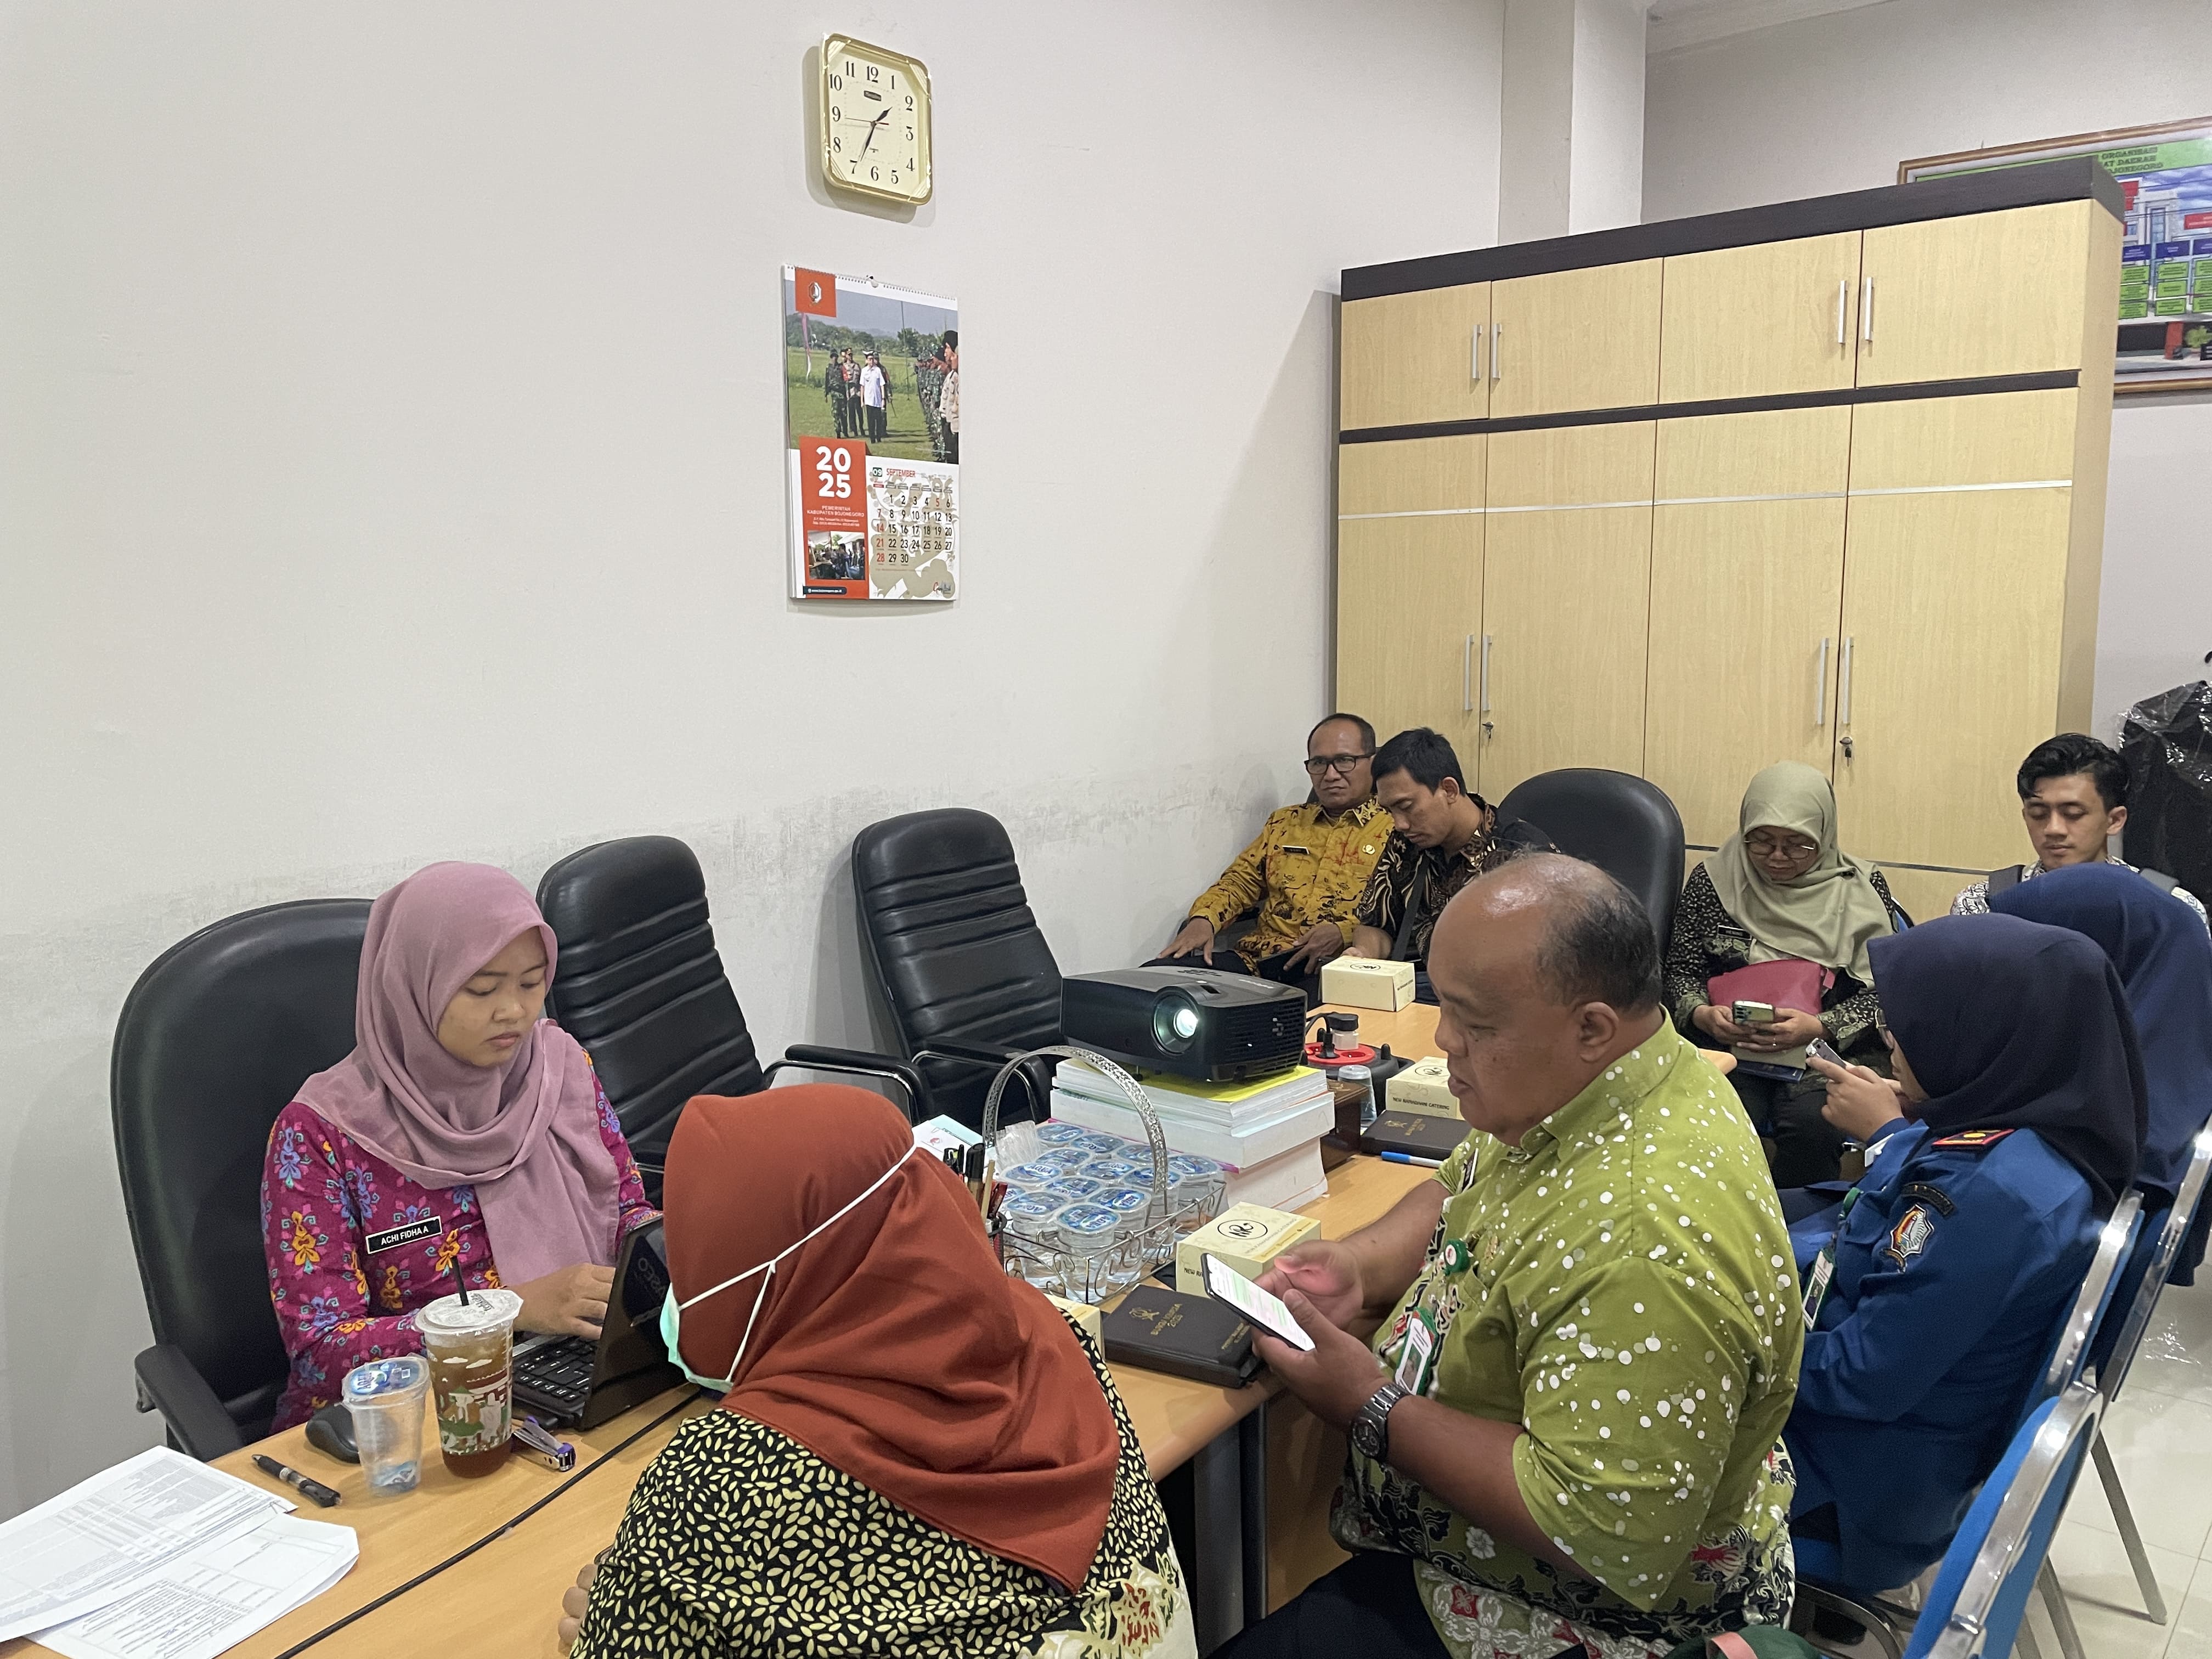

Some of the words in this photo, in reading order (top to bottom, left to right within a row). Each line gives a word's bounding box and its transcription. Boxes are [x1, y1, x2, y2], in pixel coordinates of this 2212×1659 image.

[846, 61, 855, 77] 11
[867, 66, 878, 83] 12
[830, 74, 842, 91] 10
[891, 75, 895, 89] 1
[905, 96, 913, 111] 2
[832, 106, 840, 121] 9
[906, 126, 913, 140] 3
[833, 137, 841, 153] 8
[850, 160, 857, 174] 7
[906, 158, 915, 171] 4
[2107, 162, 2164, 173] JONEGORO
[871, 166, 878, 180] 6
[891, 170, 899, 184] 5
[816, 446, 851, 472] 20
[887, 468, 916, 477] SEPTEMBER
[819, 472, 851, 498] 25
[890, 495, 893, 503] 1
[901, 495, 905, 505] 2
[913, 496, 917, 505] 3
[925, 498, 928, 506] 4
[936, 498, 939, 507] 5
[946, 499, 950, 507] 6
[877, 509, 881, 517] 7
[890, 509, 894, 518] 8
[901, 510, 906, 518] 9
[912, 511, 919, 520] 10
[923, 512, 930, 521] 11
[934, 512, 941, 521] 12
[945, 513, 952, 522] 13
[877, 523, 884, 532] 14
[889, 524, 896, 533] 15
[901, 524, 909, 534] 16
[912, 526, 919, 534] 17
[923, 526, 930, 535] 18
[935, 527, 941, 535] 19
[945, 527, 952, 537] 20
[877, 538, 884, 548] 21
[889, 539, 896, 548] 22
[900, 539, 908, 548] 23
[912, 540, 919, 549] 24
[923, 540, 930, 549] 25
[934, 541, 941, 550] 26
[945, 541, 952, 550] 27
[877, 553, 884, 562] 28
[889, 554, 896, 562] 29
[900, 554, 909, 563] 30
[1029, 1164, 1053, 1174] AQUA
[381, 1233, 399, 1245] ACHI
[400, 1228, 422, 1240] FIDHA
